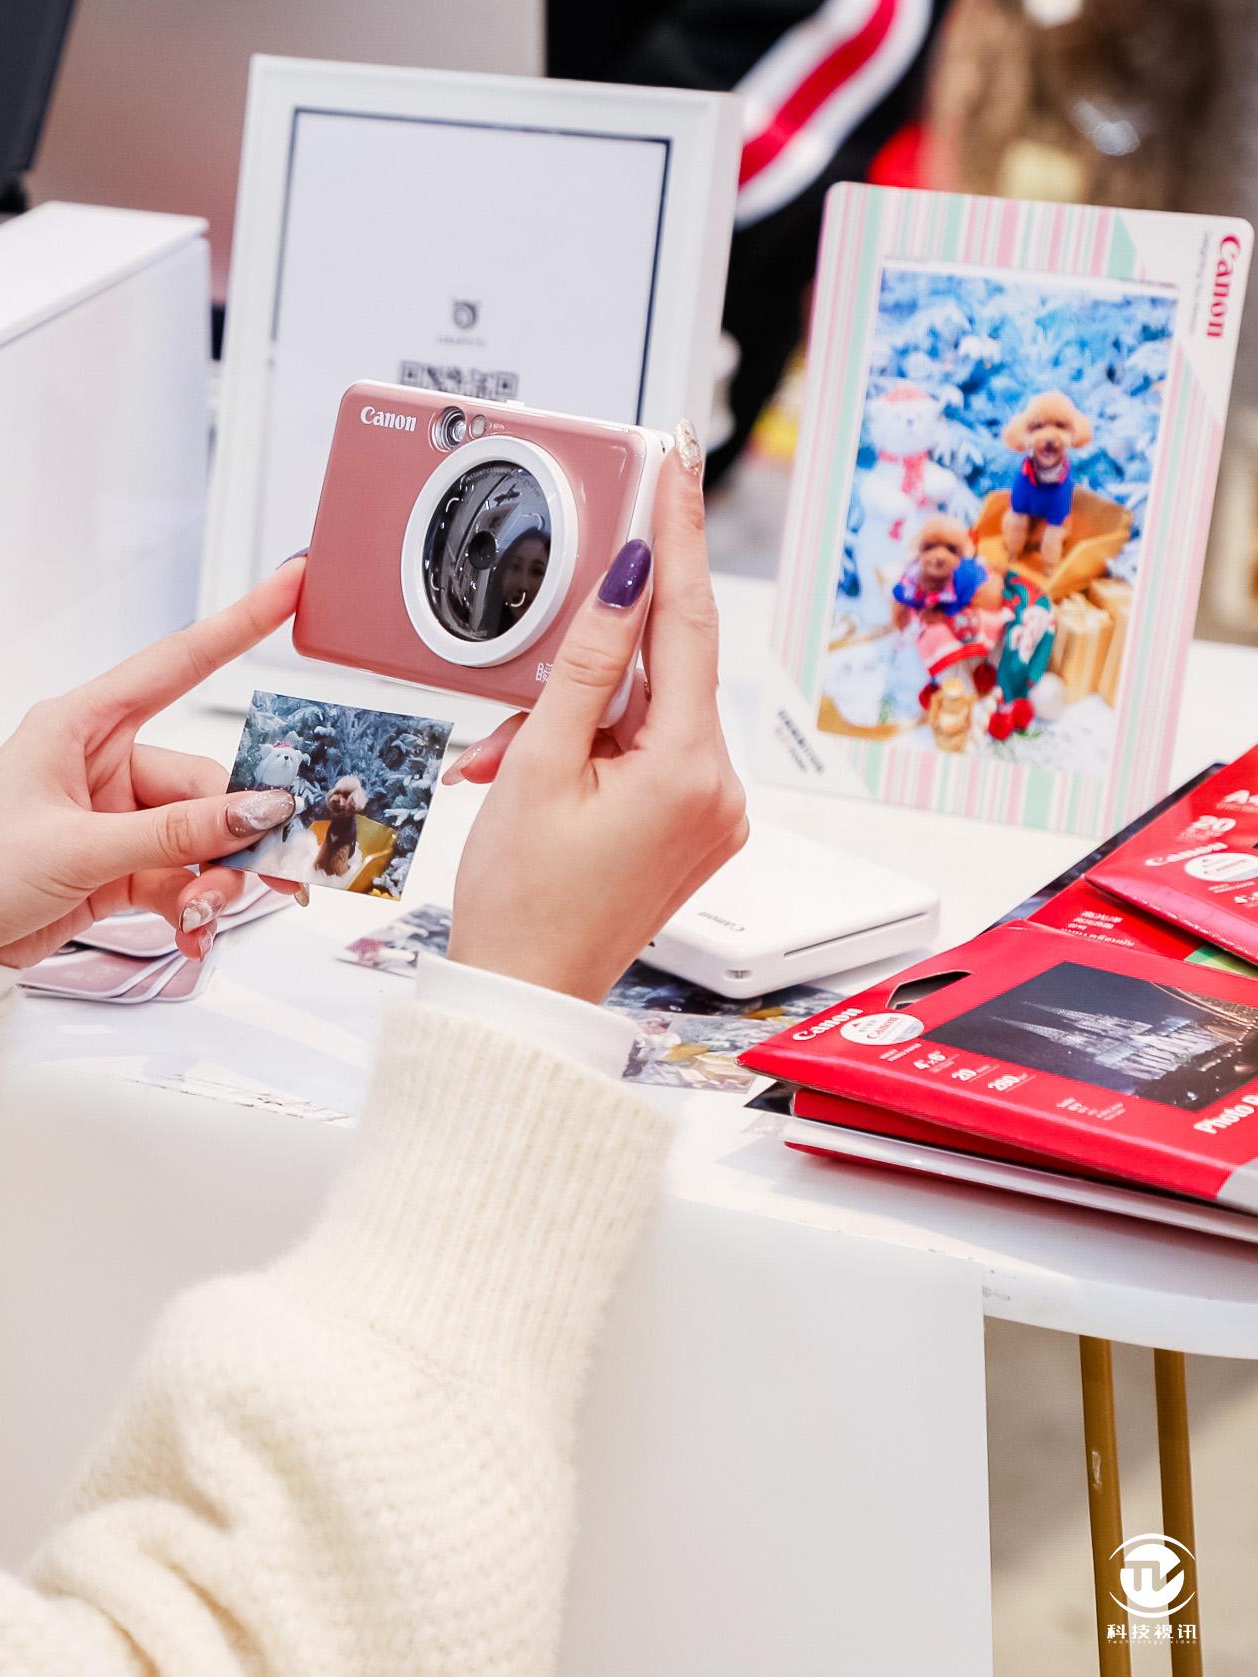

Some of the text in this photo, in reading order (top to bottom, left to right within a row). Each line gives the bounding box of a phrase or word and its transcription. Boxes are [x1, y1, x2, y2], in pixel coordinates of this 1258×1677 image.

[1206, 234, 1241, 338] Canon
[360, 405, 417, 432] Canon
[791, 1007, 864, 1041] Canon
[1193, 1104, 1255, 1135] Photo
